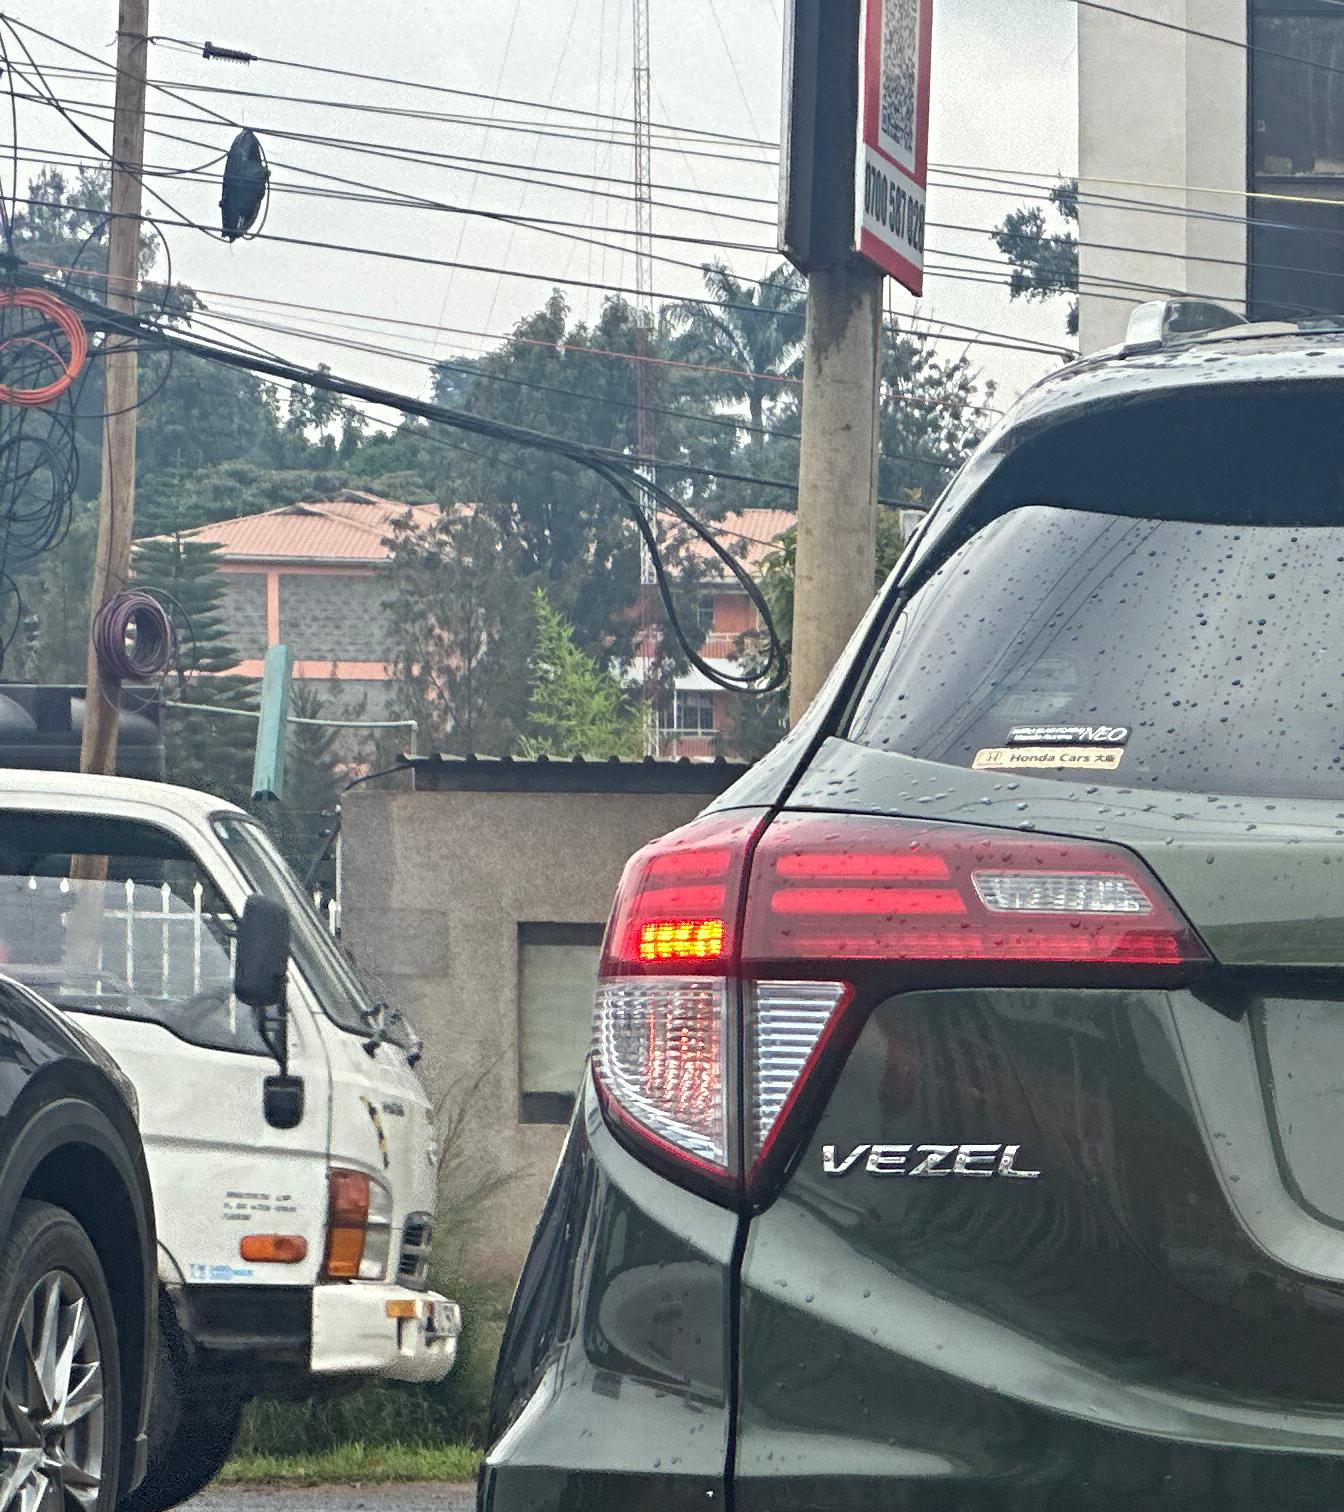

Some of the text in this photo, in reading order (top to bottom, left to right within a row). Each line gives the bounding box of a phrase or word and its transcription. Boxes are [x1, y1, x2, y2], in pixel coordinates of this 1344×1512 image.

[1010, 753, 1056, 763] Honda
[1059, 753, 1091, 763] Cars
[823, 1144, 1041, 1179] VEZEL
